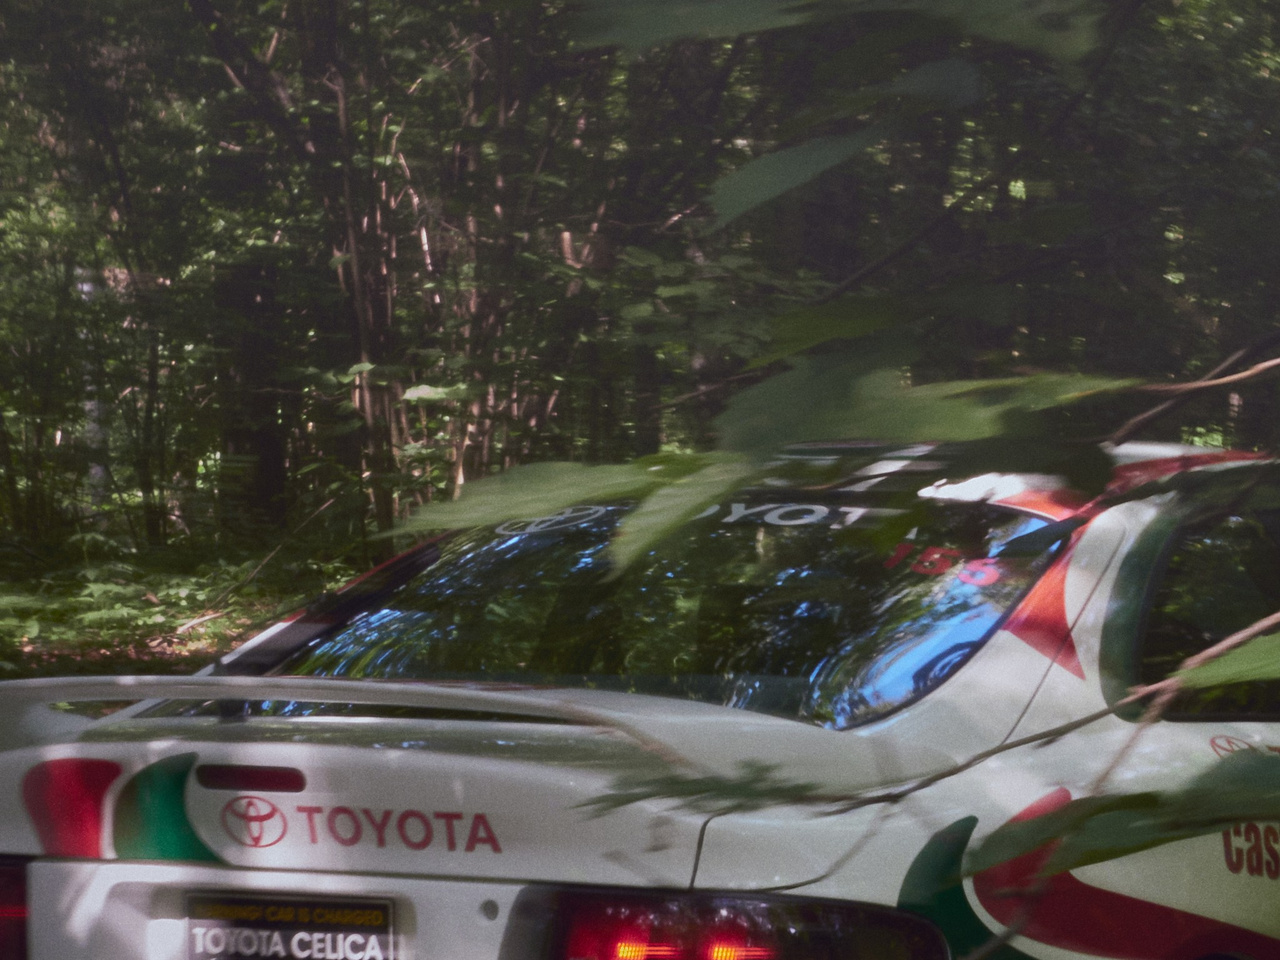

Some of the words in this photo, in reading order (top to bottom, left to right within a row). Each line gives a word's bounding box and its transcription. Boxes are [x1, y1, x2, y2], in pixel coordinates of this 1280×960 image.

[883, 543, 1001, 587] 155
[298, 804, 502, 854] TOYOTA
[192, 926, 286, 958] TOYOTA
